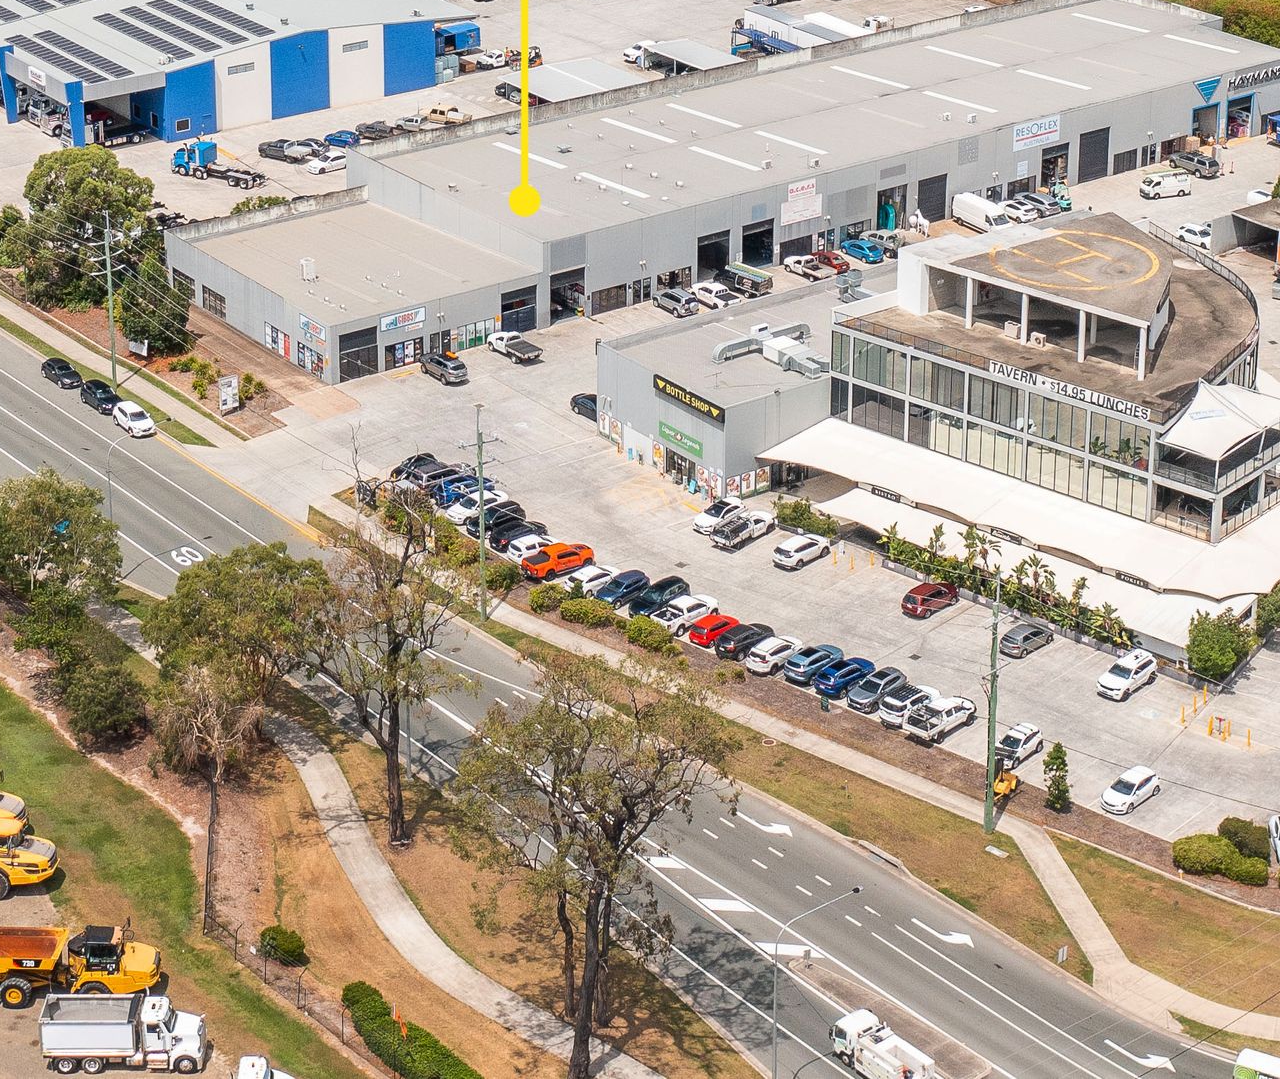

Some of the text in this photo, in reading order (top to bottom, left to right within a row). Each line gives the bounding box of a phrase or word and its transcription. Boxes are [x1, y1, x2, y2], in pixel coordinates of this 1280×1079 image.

[1016, 119, 1058, 138] RESOFLEX
[398, 312, 414, 325] GIBBS
[666, 384, 710, 412] BOTTLE SHOP
[991, 362, 1148, 420] TAVERN $14.95 LUNCHES
[875, 488, 896, 500] BISTRO
[171, 546, 204, 566] 60
[1120, 573, 1143, 586] POKIES
